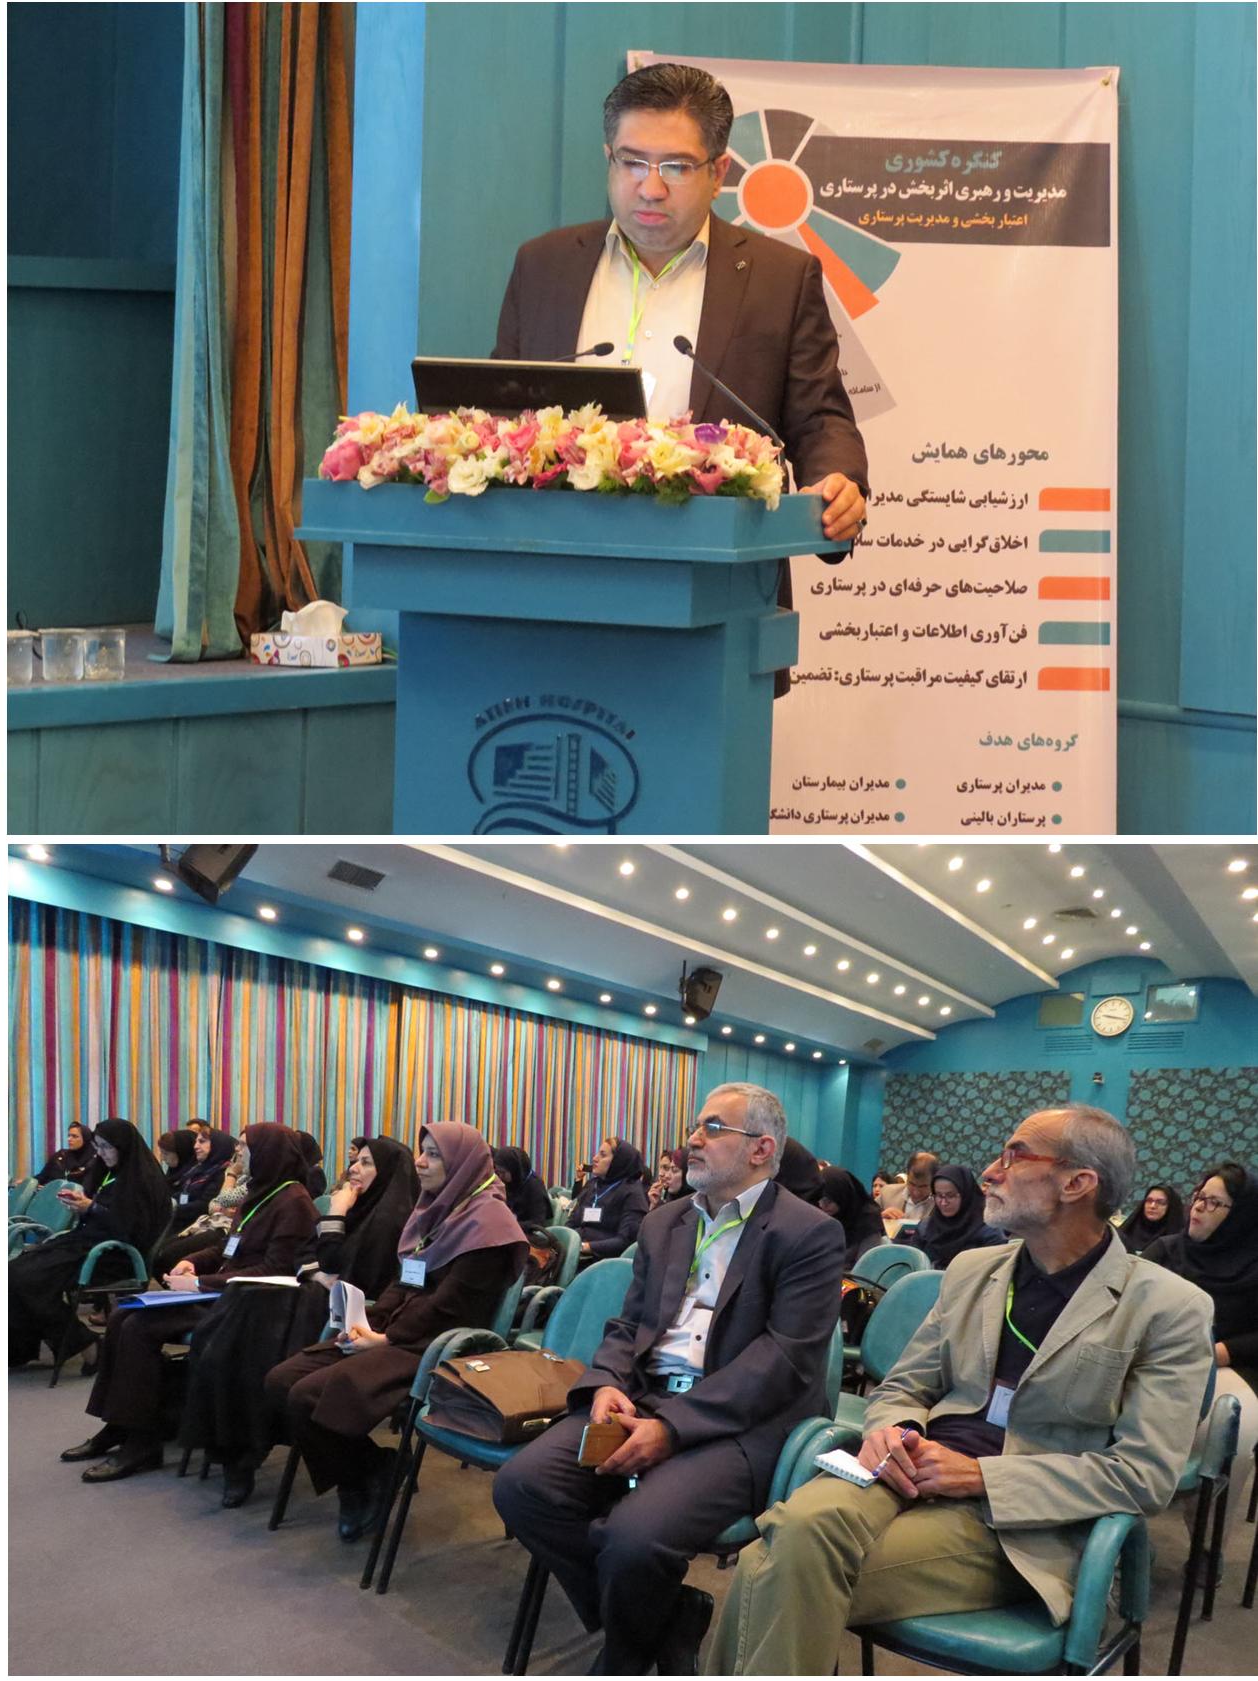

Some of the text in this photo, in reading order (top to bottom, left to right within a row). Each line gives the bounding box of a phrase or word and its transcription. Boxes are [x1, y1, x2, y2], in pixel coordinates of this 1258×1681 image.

[885, 150, 950, 173] کشوری
[819, 177, 878, 200] پرستاری
[880, 181, 897, 199] در
[955, 181, 1001, 202] رهبری
[1013, 183, 1068, 204] مدیریت
[858, 209, 905, 227] پرستاری
[907, 212, 950, 228] مدیریت
[960, 212, 995, 229] بخشی
[997, 213, 1028, 229] اعتبار
[911, 441, 968, 463] همایش
[868, 487, 1029, 510] ارزشیابی شایستگی مدیرا
[876, 533, 924, 549] خدمات
[930, 535, 945, 553] در
[810, 577, 866, 597] پرستاری
[870, 580, 887, 596] در
[901, 627, 910, 642] و
[912, 622, 968, 639] اطلاعات
[789, 667, 833, 687] تضمین
[895, 668, 942, 688] مراقبت
[944, 669, 984, 688] کیفیت
[985, 669, 1028, 690] ارتقای
[978, 730, 1013, 748] هدف
[792, 775, 890, 792] مدیران بیمارستان
[956, 777, 1046, 794] مدیران پرستاری
[803, 808, 849, 825] پرستاری
[850, 808, 890, 824] مدیران
[960, 810, 1046, 828] پرستاران بالینی
